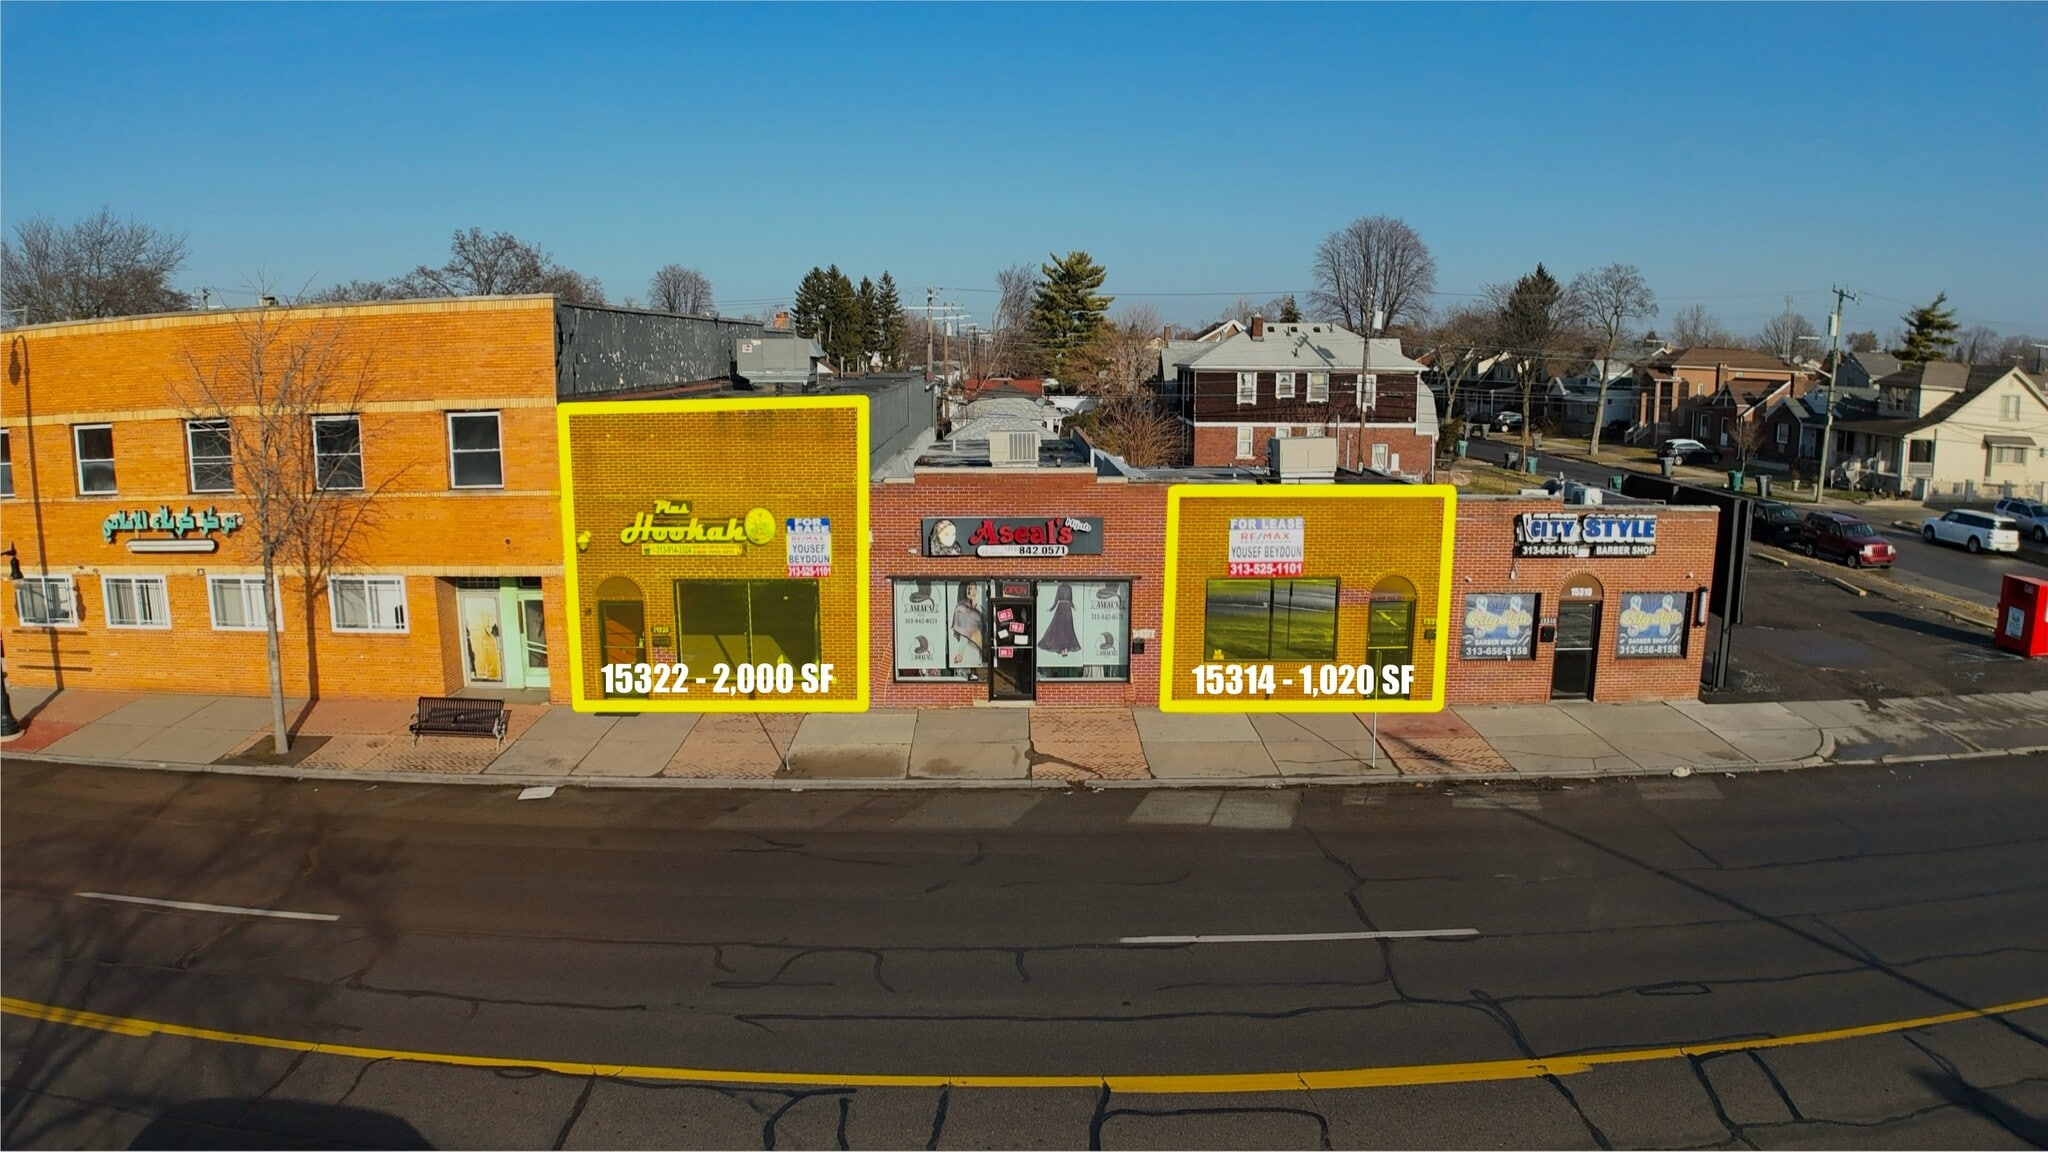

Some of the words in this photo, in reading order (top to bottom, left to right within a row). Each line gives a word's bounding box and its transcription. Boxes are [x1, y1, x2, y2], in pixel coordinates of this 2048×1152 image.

[655, 500, 690, 514] Plus
[794, 517, 821, 526] FOR
[1230, 518, 1257, 530] FOR
[1262, 518, 1304, 530] LEASE
[620, 511, 747, 544] Hookah
[787, 525, 830, 534] LEASE
[969, 518, 1073, 545] Aseal's
[1530, 520, 1575, 538] CITY
[1585, 518, 1656, 538] STYLE
[1240, 532, 1290, 540] RE/MAX
[792, 544, 826, 554] YOUSEF
[1231, 546, 1262, 558] YOUSEF
[1264, 546, 1302, 558] BEYDOUN
[1522, 545, 1578, 556] 313-656-8158
[1595, 546, 1630, 555] BARBER
[1631, 545, 1655, 555] SHOP
[789, 555, 830, 564] BEYDOUN
[787, 566, 832, 577] 313-525-1101
[1230, 563, 1302, 575] 313-525-1101
[1465, 647, 1528, 656] 313-656-8158
[1619, 645, 1678, 654] 313-656-8158
